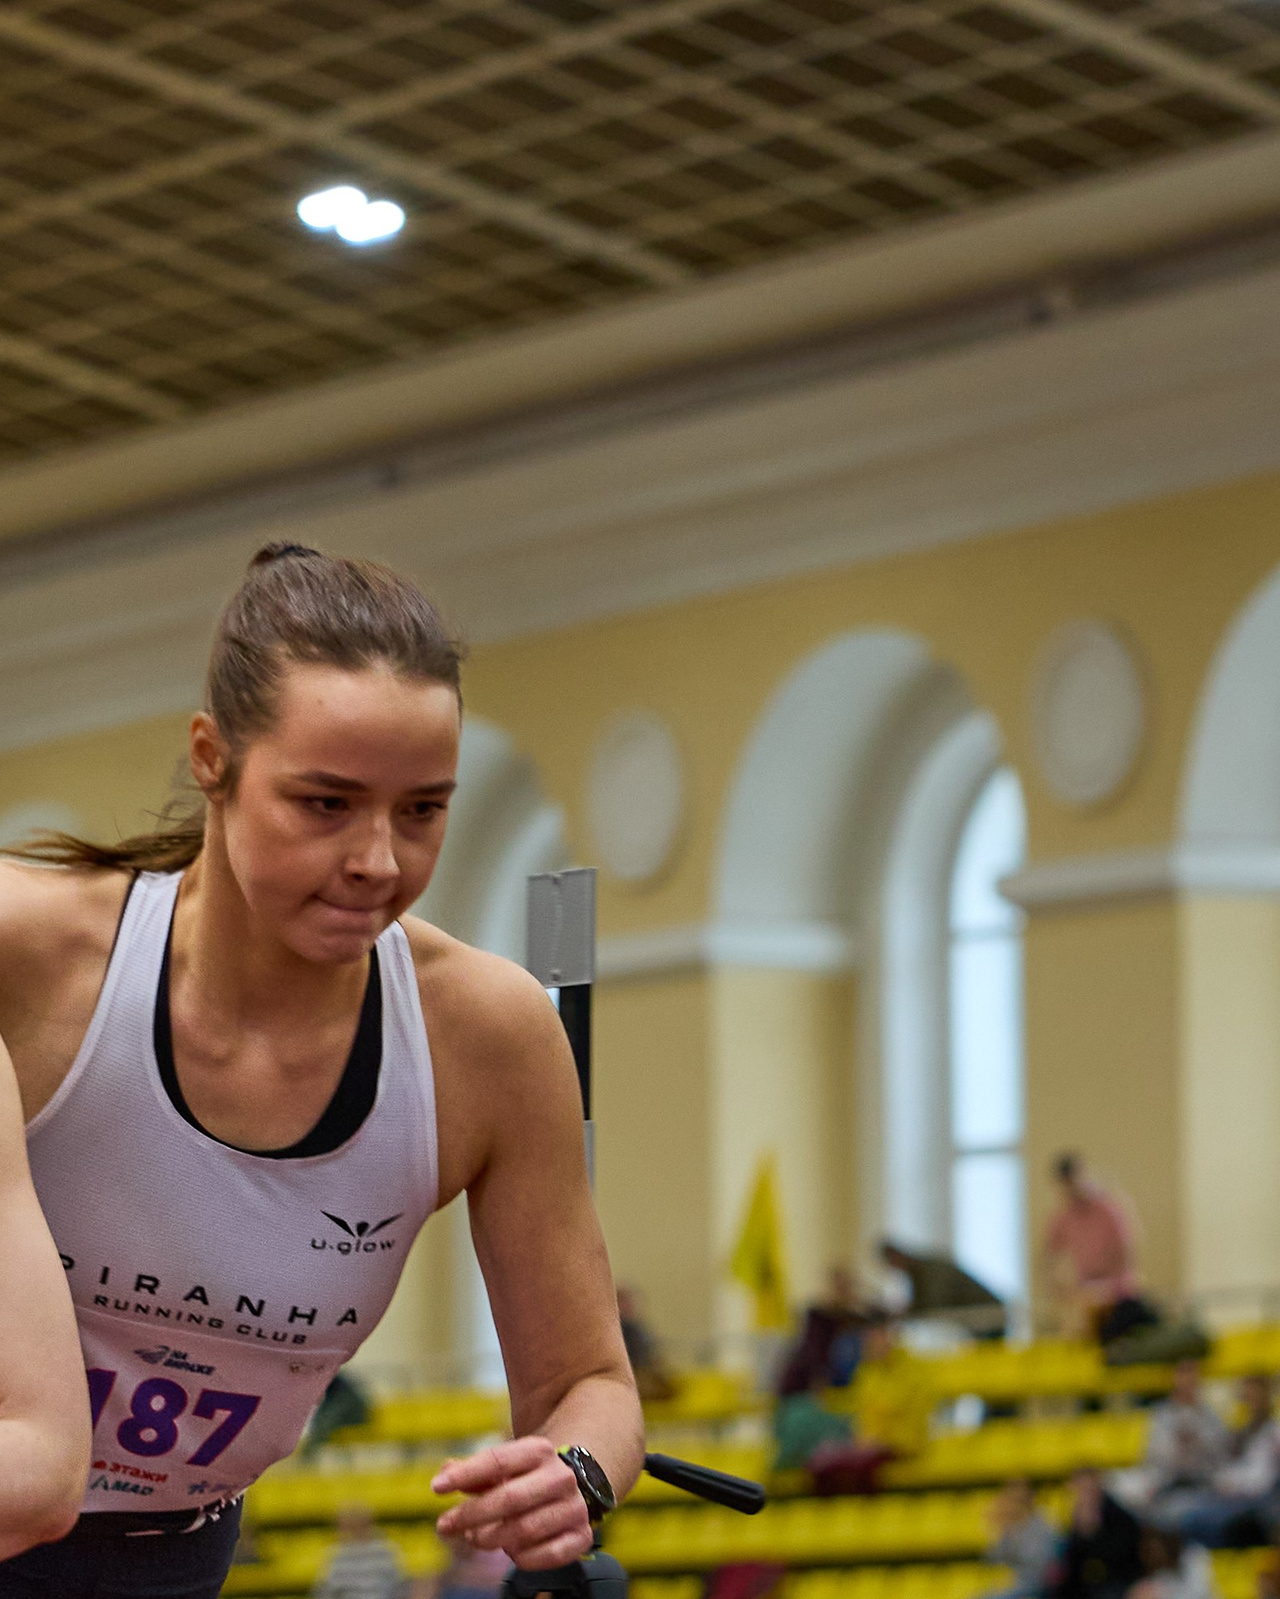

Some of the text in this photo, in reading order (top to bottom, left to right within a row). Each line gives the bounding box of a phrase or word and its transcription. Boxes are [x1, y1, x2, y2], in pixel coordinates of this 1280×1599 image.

[93, 1293, 308, 1346] RUNNING CLUB
[86, 1367, 263, 1468] 187
